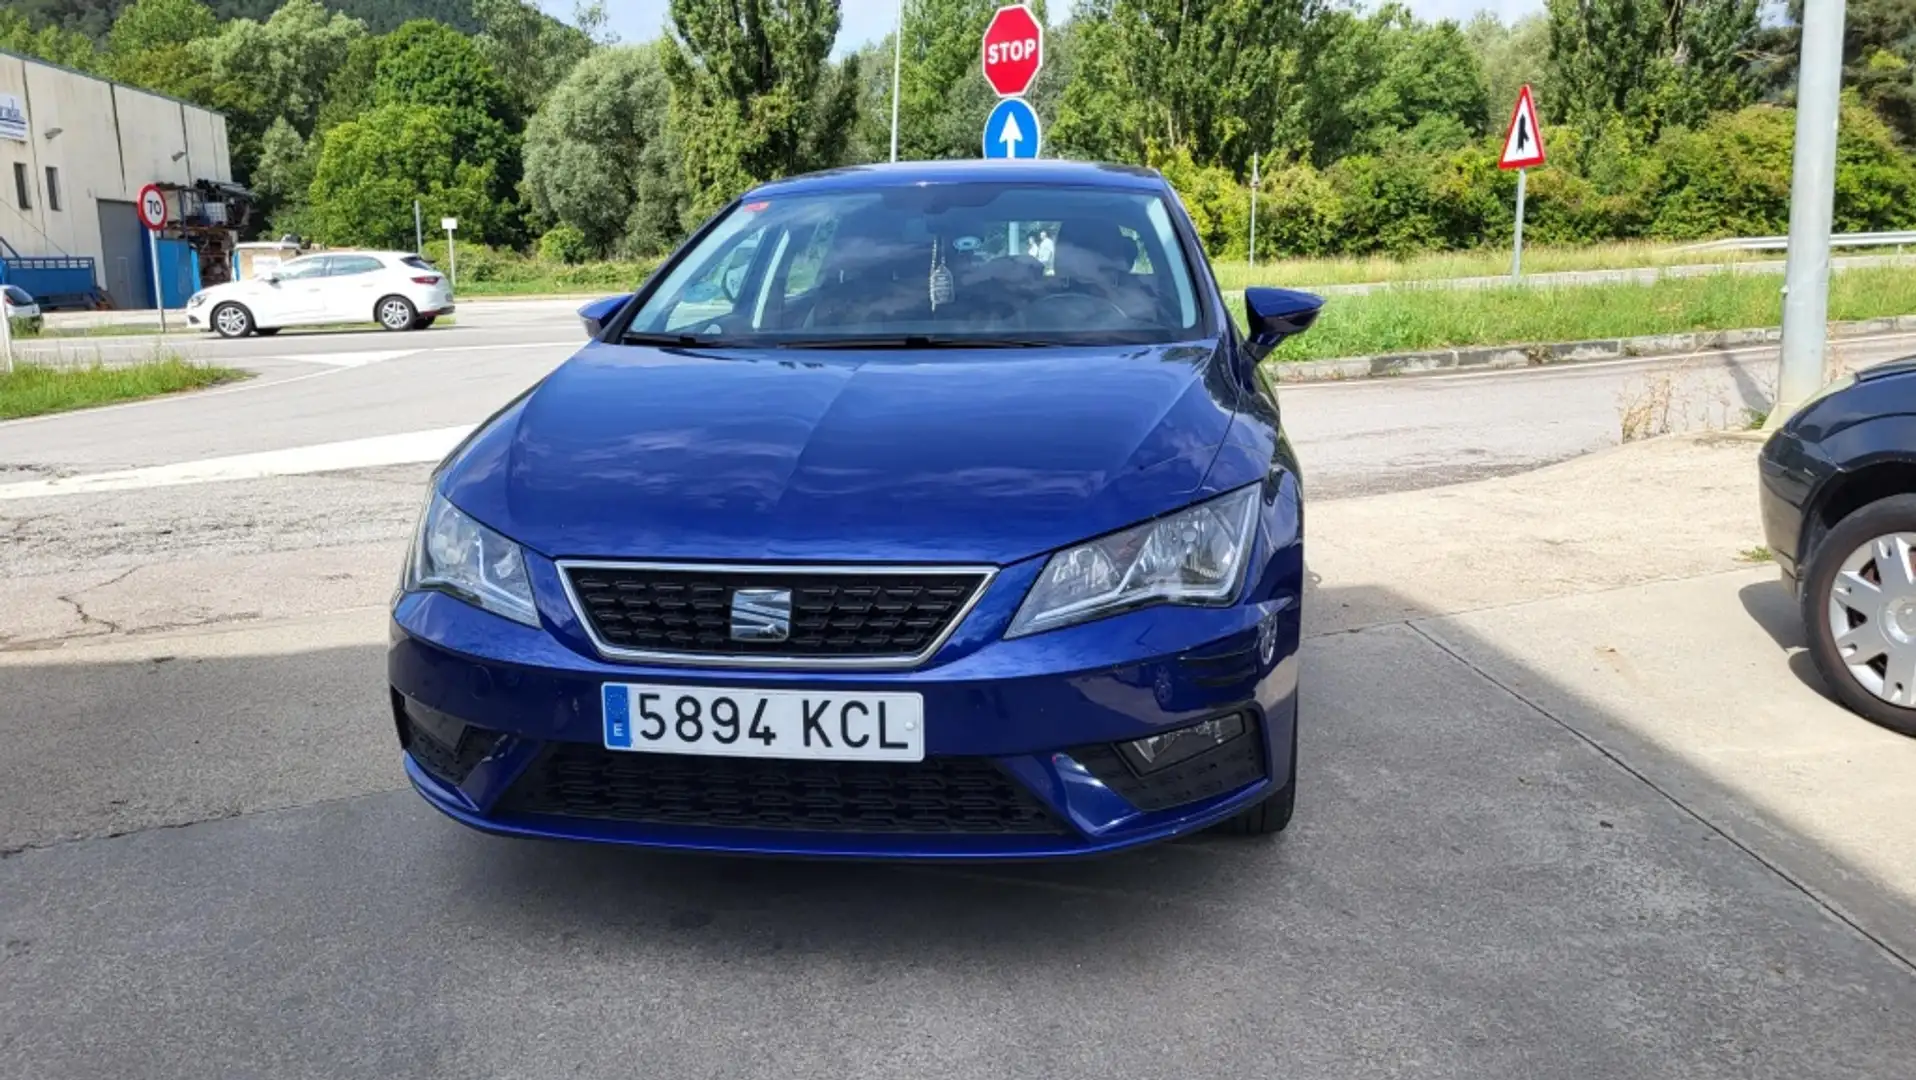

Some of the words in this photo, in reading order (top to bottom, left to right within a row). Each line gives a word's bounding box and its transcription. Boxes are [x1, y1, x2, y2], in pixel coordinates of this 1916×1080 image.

[988, 38, 1036, 65] STOP
[146, 200, 162, 216] 70
[613, 722, 625, 737] E
[638, 692, 777, 746] 5894
[802, 699, 909, 749] KCL
